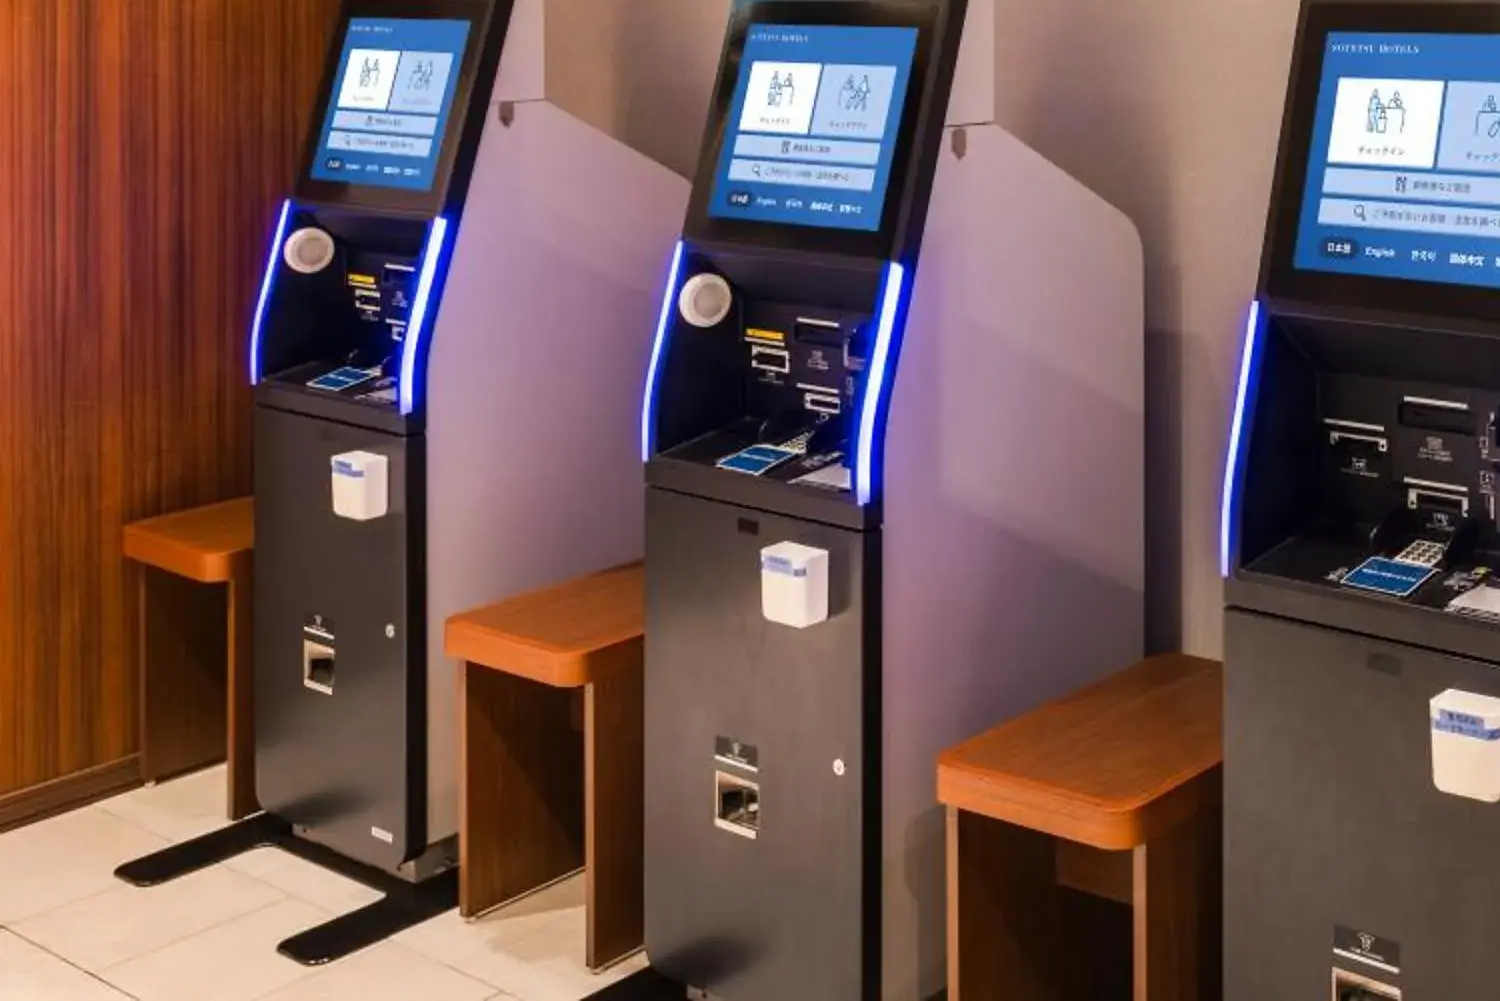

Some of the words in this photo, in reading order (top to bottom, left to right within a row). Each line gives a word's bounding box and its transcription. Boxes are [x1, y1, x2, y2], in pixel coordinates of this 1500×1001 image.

[1327, 242, 1351, 254] 日本語
[1365, 246, 1396, 259] English
